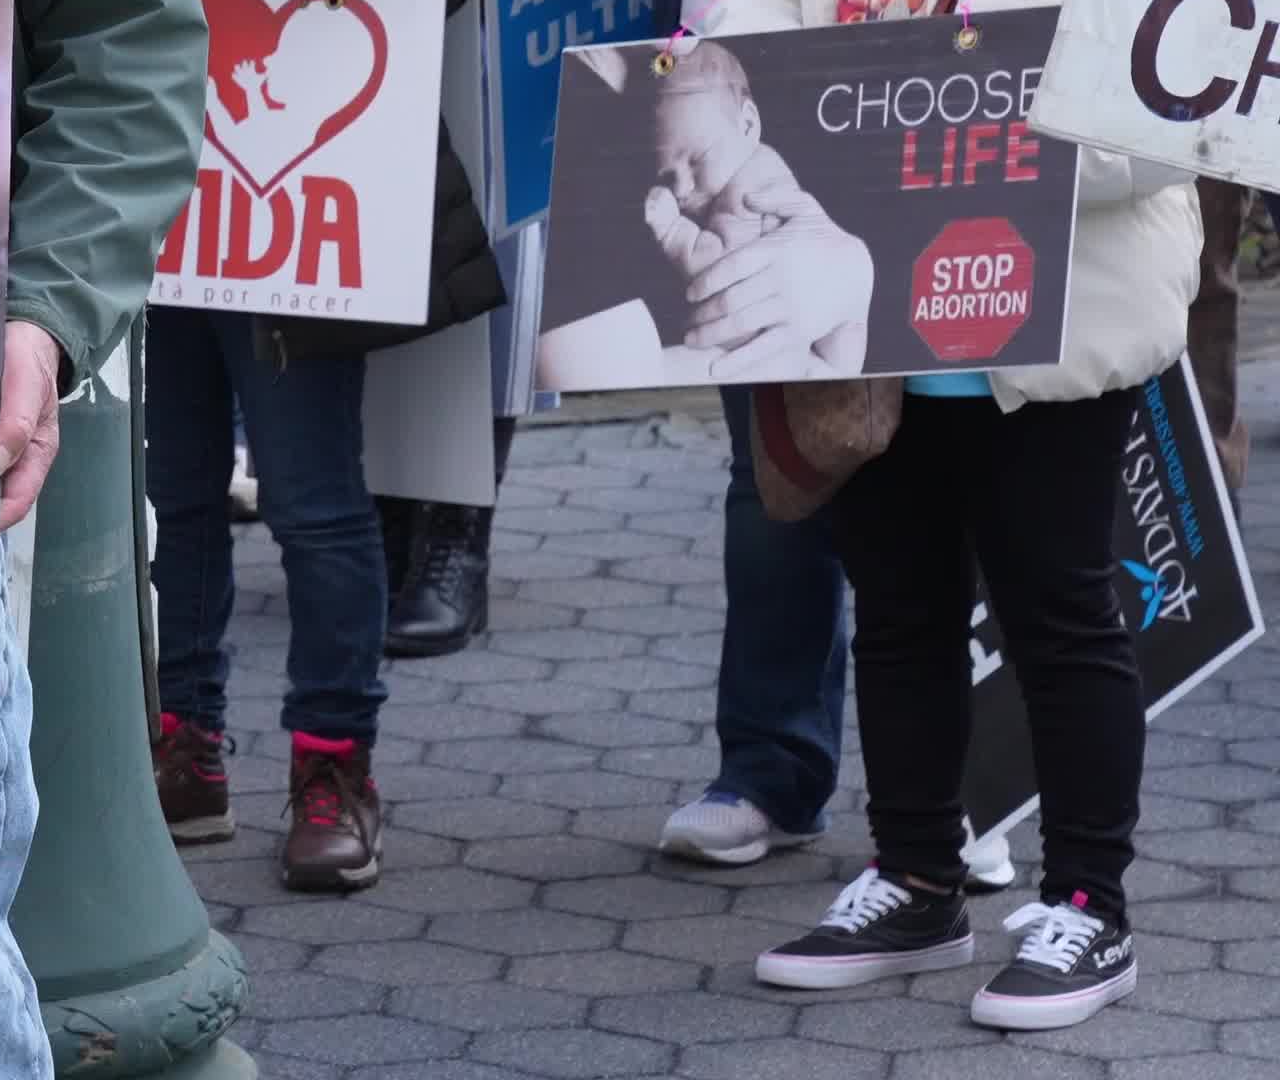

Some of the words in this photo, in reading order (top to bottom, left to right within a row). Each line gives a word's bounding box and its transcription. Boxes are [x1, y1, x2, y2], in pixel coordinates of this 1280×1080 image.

[817, 67, 1044, 133] CHOOSE
[900, 120, 1040, 190] LIFE
[931, 252, 1015, 293] STOP
[203, 286, 249, 305] por
[270, 291, 354, 313] nacer
[914, 289, 1028, 322] ABORTION
